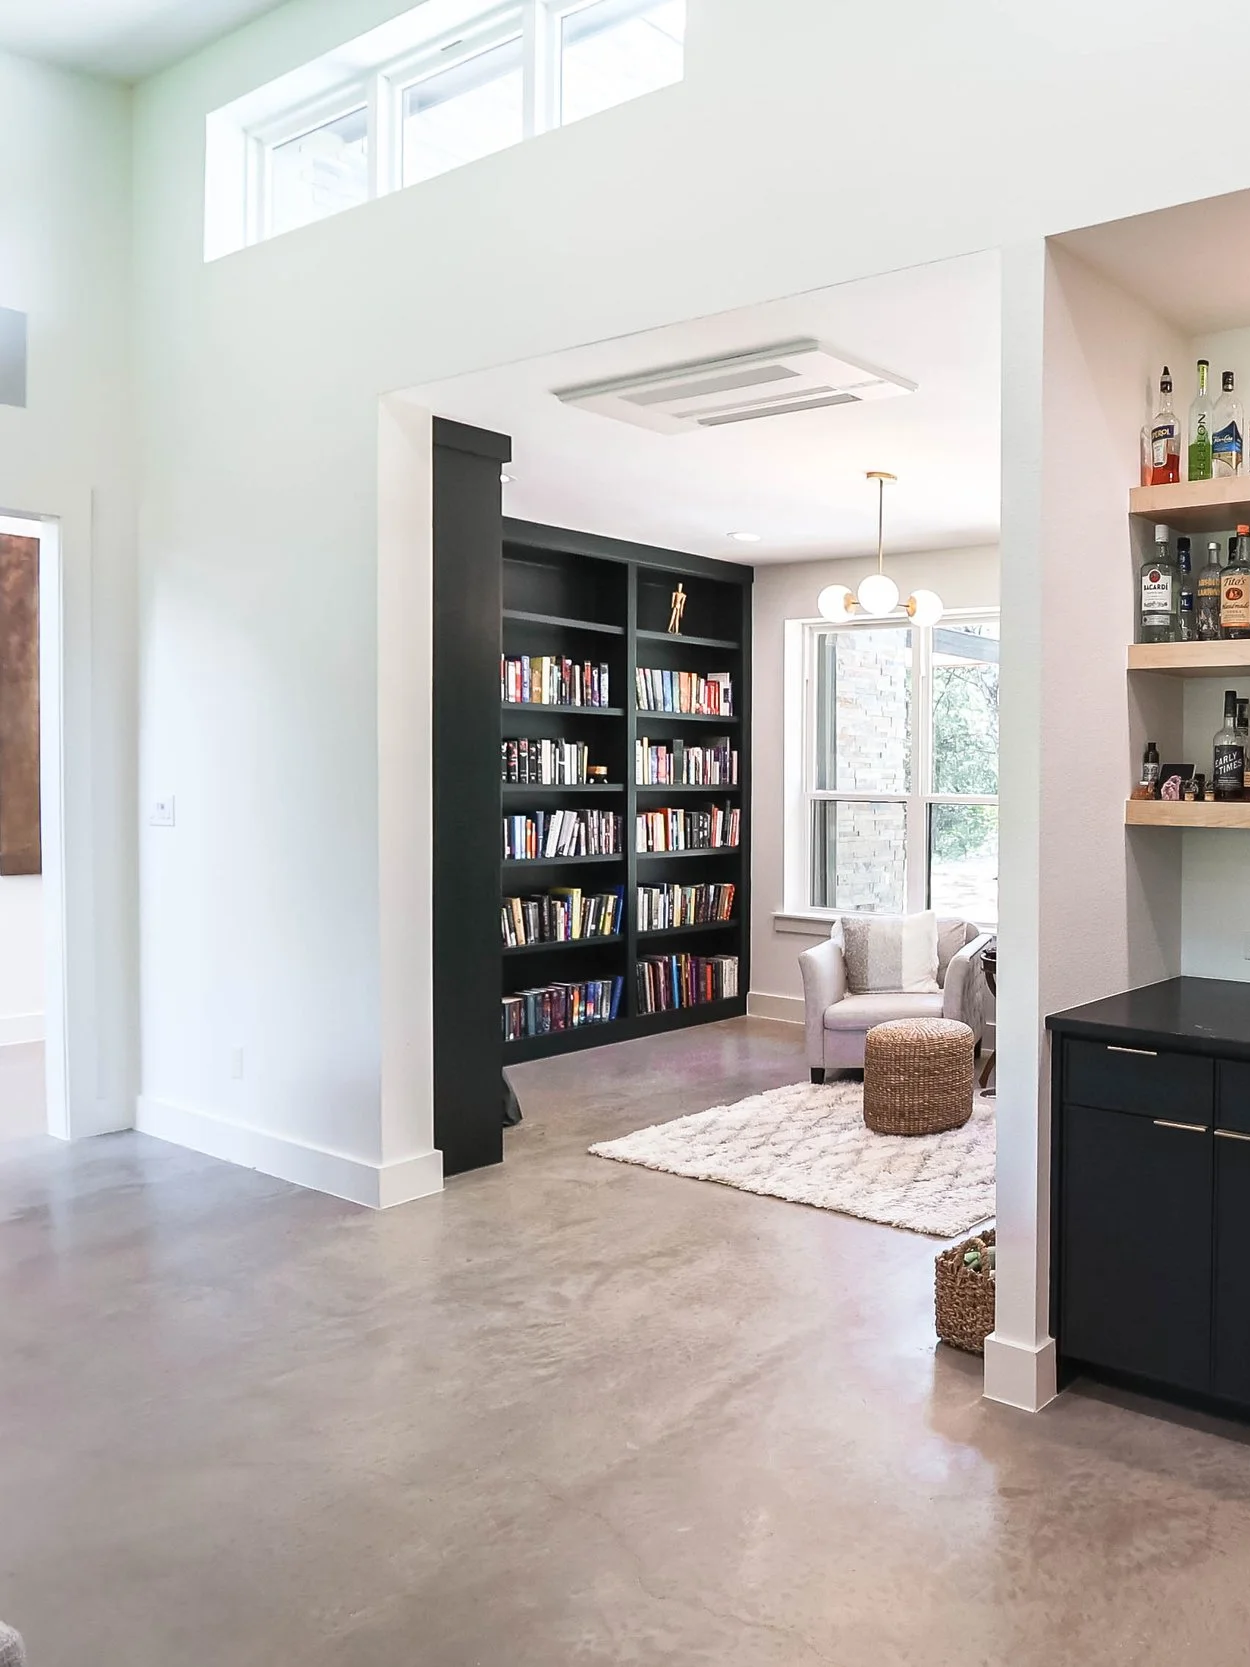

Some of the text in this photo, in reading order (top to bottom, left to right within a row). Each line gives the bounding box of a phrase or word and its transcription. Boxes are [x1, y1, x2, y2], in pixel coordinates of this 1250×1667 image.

[1224, 577, 1246, 587] Tito's
[1215, 751, 1238, 768] EARLY
[1218, 758, 1243, 775] TIMES
